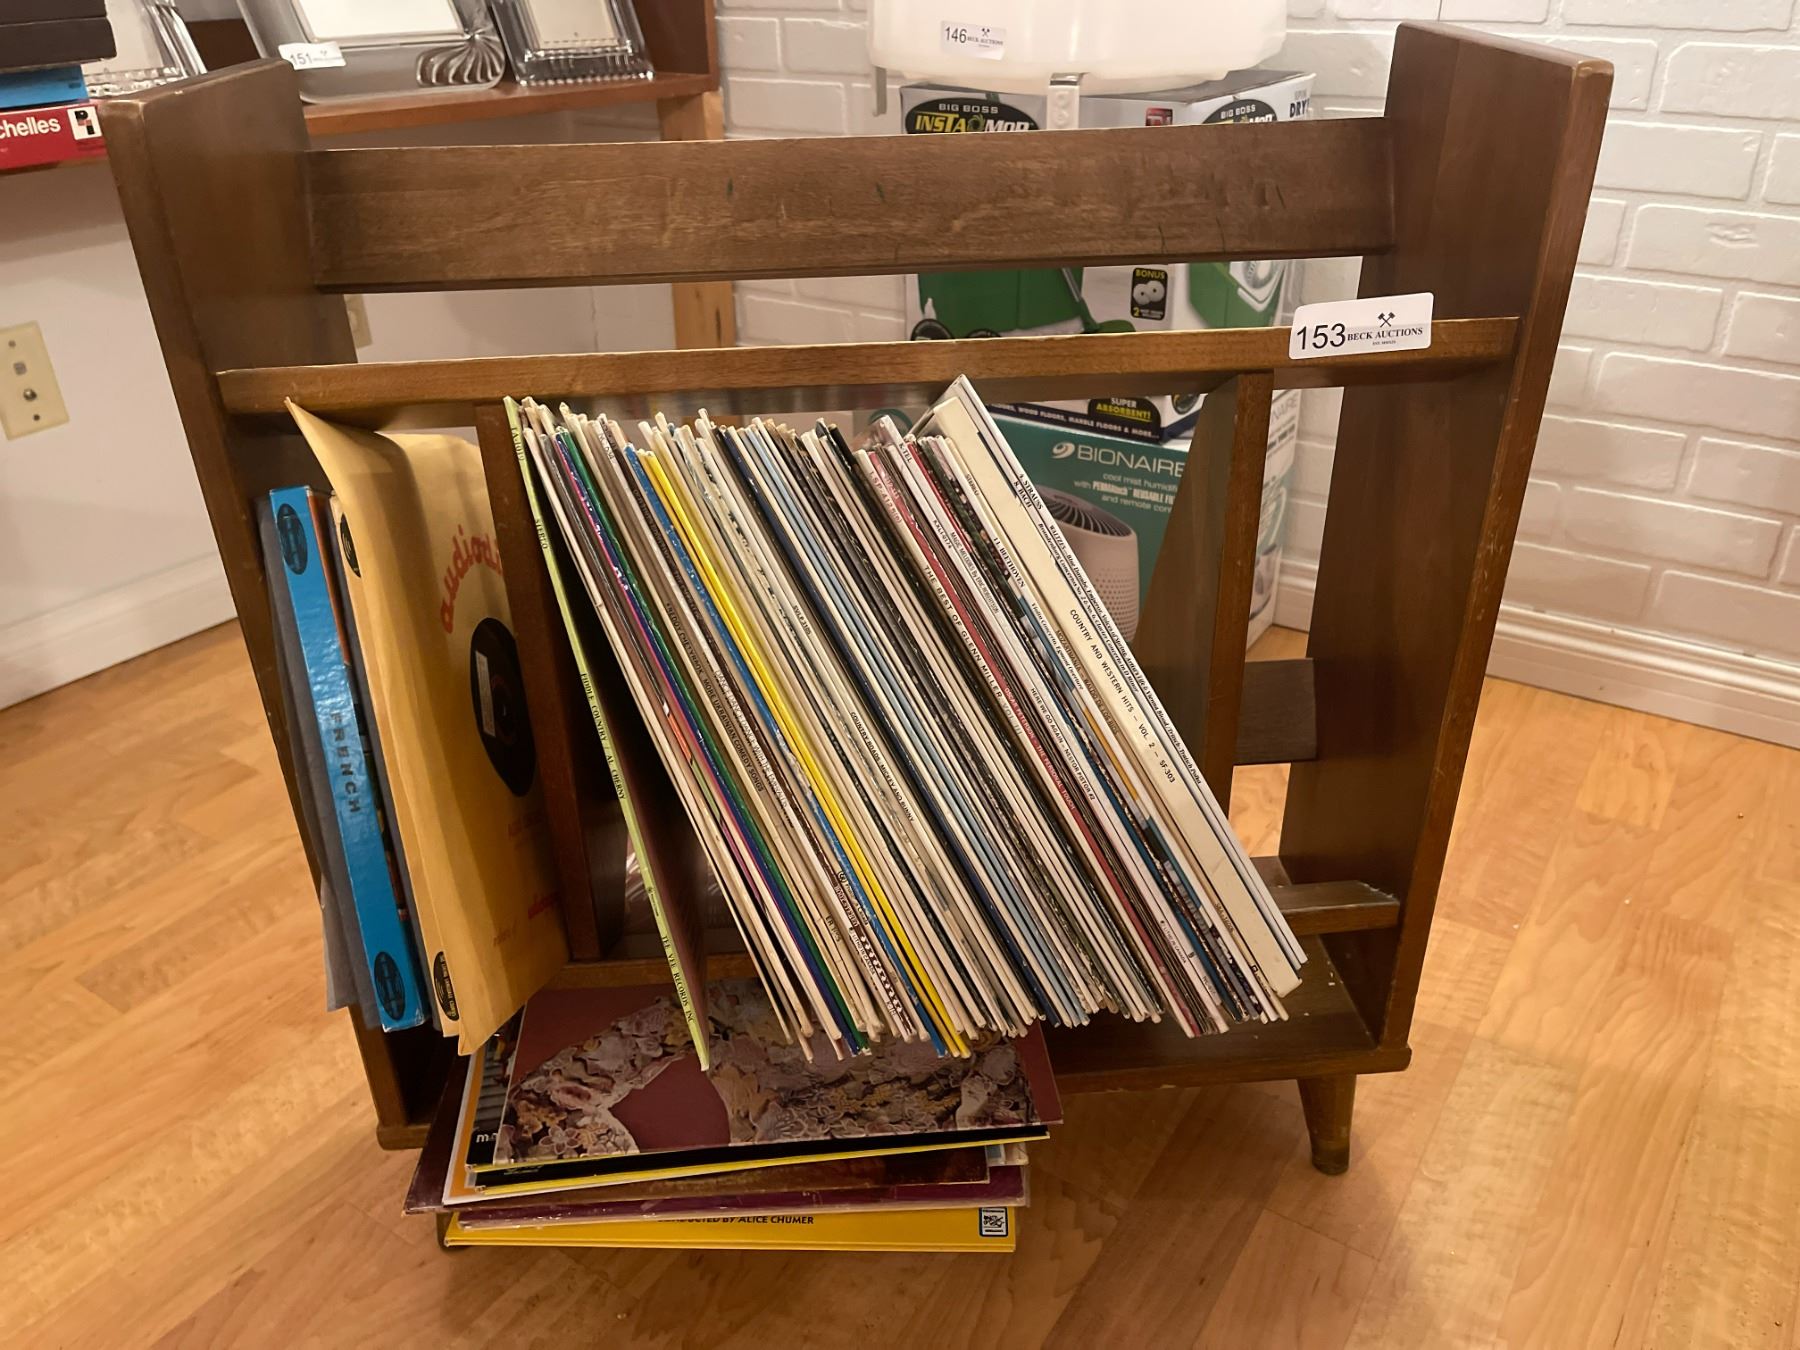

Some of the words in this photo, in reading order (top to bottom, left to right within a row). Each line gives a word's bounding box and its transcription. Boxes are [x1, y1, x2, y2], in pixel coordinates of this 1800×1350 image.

[945, 27, 967, 43] 146
[290, 53, 312, 65] 151
[963, 105, 998, 114] BOSS
[1221, 109, 1234, 119] BIG
[1235, 104, 1256, 114] BOSS
[1135, 269, 1165, 279] BONUS
[1133, 307, 1140, 317] 2
[1297, 323, 1346, 350] 153
[1347, 331, 1373, 341] BECK
[1374, 328, 1423, 339] AUCTIONS
[1096, 403, 1152, 419] ABSORBENT!
[1111, 397, 1137, 408] SUPER
[1077, 445, 1185, 477] BIONAIRE
[534, 518, 549, 550] STEREO
[898, 442, 912, 463] K-TEL
[949, 531, 962, 548] MAGIC
[958, 547, 975, 571] MELODIES
[975, 576, 984, 588] ERIC
[980, 586, 999, 614] ROBERTSON
[964, 473, 980, 496] STEREO
[1054, 629, 1082, 671] MOZARTMANIA
[1082, 678, 1098, 699] WALDO
[1095, 699, 1103, 708] DE
[1099, 707, 1110, 720] LOS
[1107, 720, 1119, 735] RIOS
[1018, 488, 1031, 508] BACH
[1037, 522, 1061, 560] Brandenburg
[1104, 638, 1122, 664] Concerto
[1126, 675, 1139, 693] Minor
[999, 547, 1025, 588] BEETHOVEN
[1030, 602, 1043, 620] Violin
[1055, 644, 1070, 666] Egmont
[1066, 664, 1084, 690] Overture
[1022, 480, 1043, 510] STRAUSS
[1145, 690, 1160, 710] Vienna
[1190, 767, 1202, 784] Polka
[923, 565, 936, 584] THE
[935, 587, 952, 611] BEST
[951, 613, 961, 626] OF
[960, 630, 981, 662] GLENN
[1013, 724, 1023, 735] III
[1069, 608, 1092, 642] COUNTRY
[1090, 643, 1103, 659] AND
[1100, 660, 1123, 694] WESTERN
[1120, 695, 1134, 712] HITS
[580, 672, 594, 700] FIDDLE
[591, 704, 608, 742] COUNTRY
[702, 678, 716, 699] MORE
[712, 699, 737, 739] UKRAINIAN
[733, 738, 752, 768] COMEDY
[748, 768, 764, 792] SONGS
[606, 754, 615, 765] AL
[1003, 687, 1018, 708] OSCAR
[1015, 708, 1035, 738] PETERSON
[1036, 745, 1045, 757] THE
[1043, 757, 1063, 788] PERSONAL
[1060, 788, 1075, 810] TOUCH
[1030, 688, 1042, 704] HERE
[1039, 704, 1047, 713] WE
[1044, 714, 1052, 724] GO
[1049, 723, 1063, 743] AGAIN
[1063, 748, 1079, 772] NESTOR
[1076, 771, 1091, 793] PISTOR
[1087, 792, 1095, 800] #2
[330, 712, 360, 813] FRENCH
[850, 711, 869, 741] COUNTRY
[866, 740, 880, 761] ROADS
[879, 764, 895, 787] MICKEY
[892, 787, 902, 801] AND
[900, 800, 914, 822] BUNNY
[610, 768, 626, 800] CHERNY
[714, 669, 730, 693] DANCE
[727, 694, 743, 719] DANCE
[739, 718, 756, 744] DANCE
[752, 744, 765, 762] WITH
[761, 760, 770, 772] THE
[862, 954, 875, 975] CANADA
[856, 906, 869, 925] Canada
[661, 935, 670, 950] TEE
[666, 953, 676, 968] VEE
[673, 972, 688, 1006] RECORDS
[685, 1010, 693, 1022] INC
[770, 1216, 814, 1224] CHUMER
